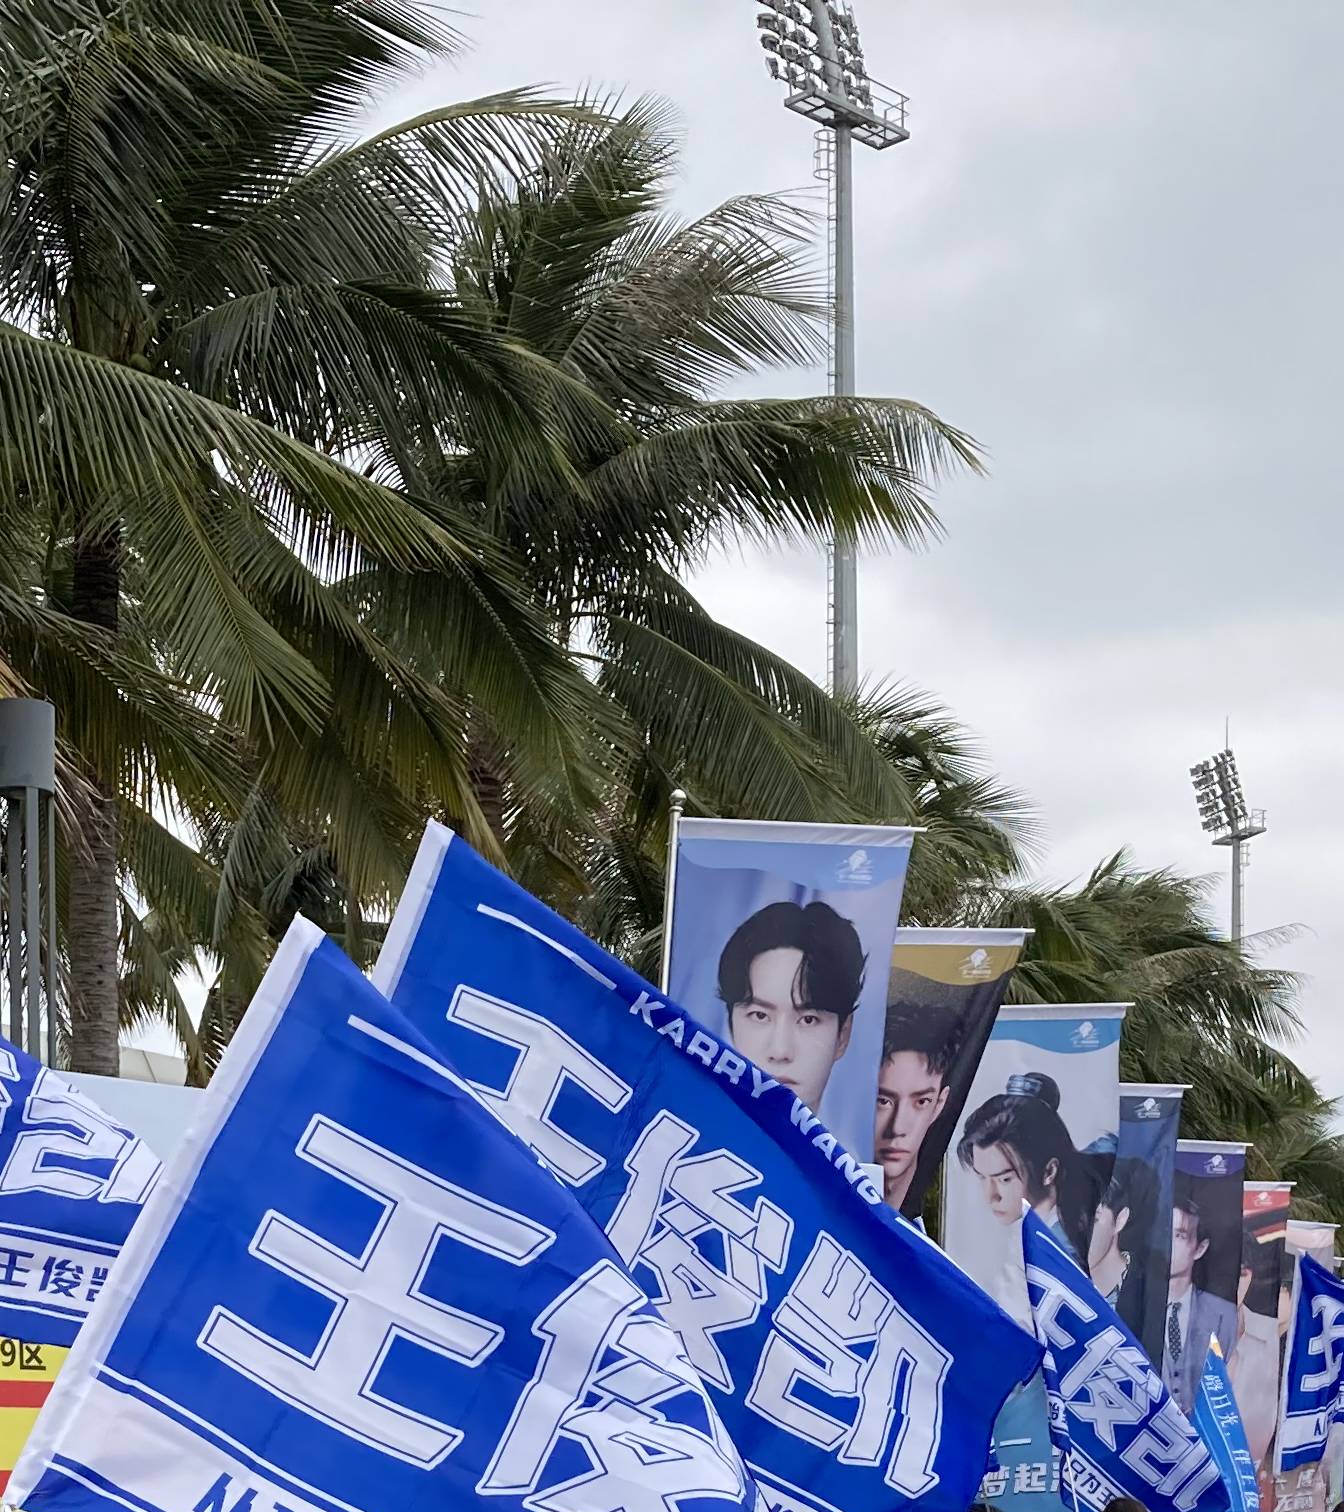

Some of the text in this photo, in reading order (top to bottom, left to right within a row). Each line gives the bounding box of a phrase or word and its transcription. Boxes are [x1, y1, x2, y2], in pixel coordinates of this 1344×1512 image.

[630, 992, 884, 1206] KARRY WANG
[0, 1339, 47, 1371] 9区
